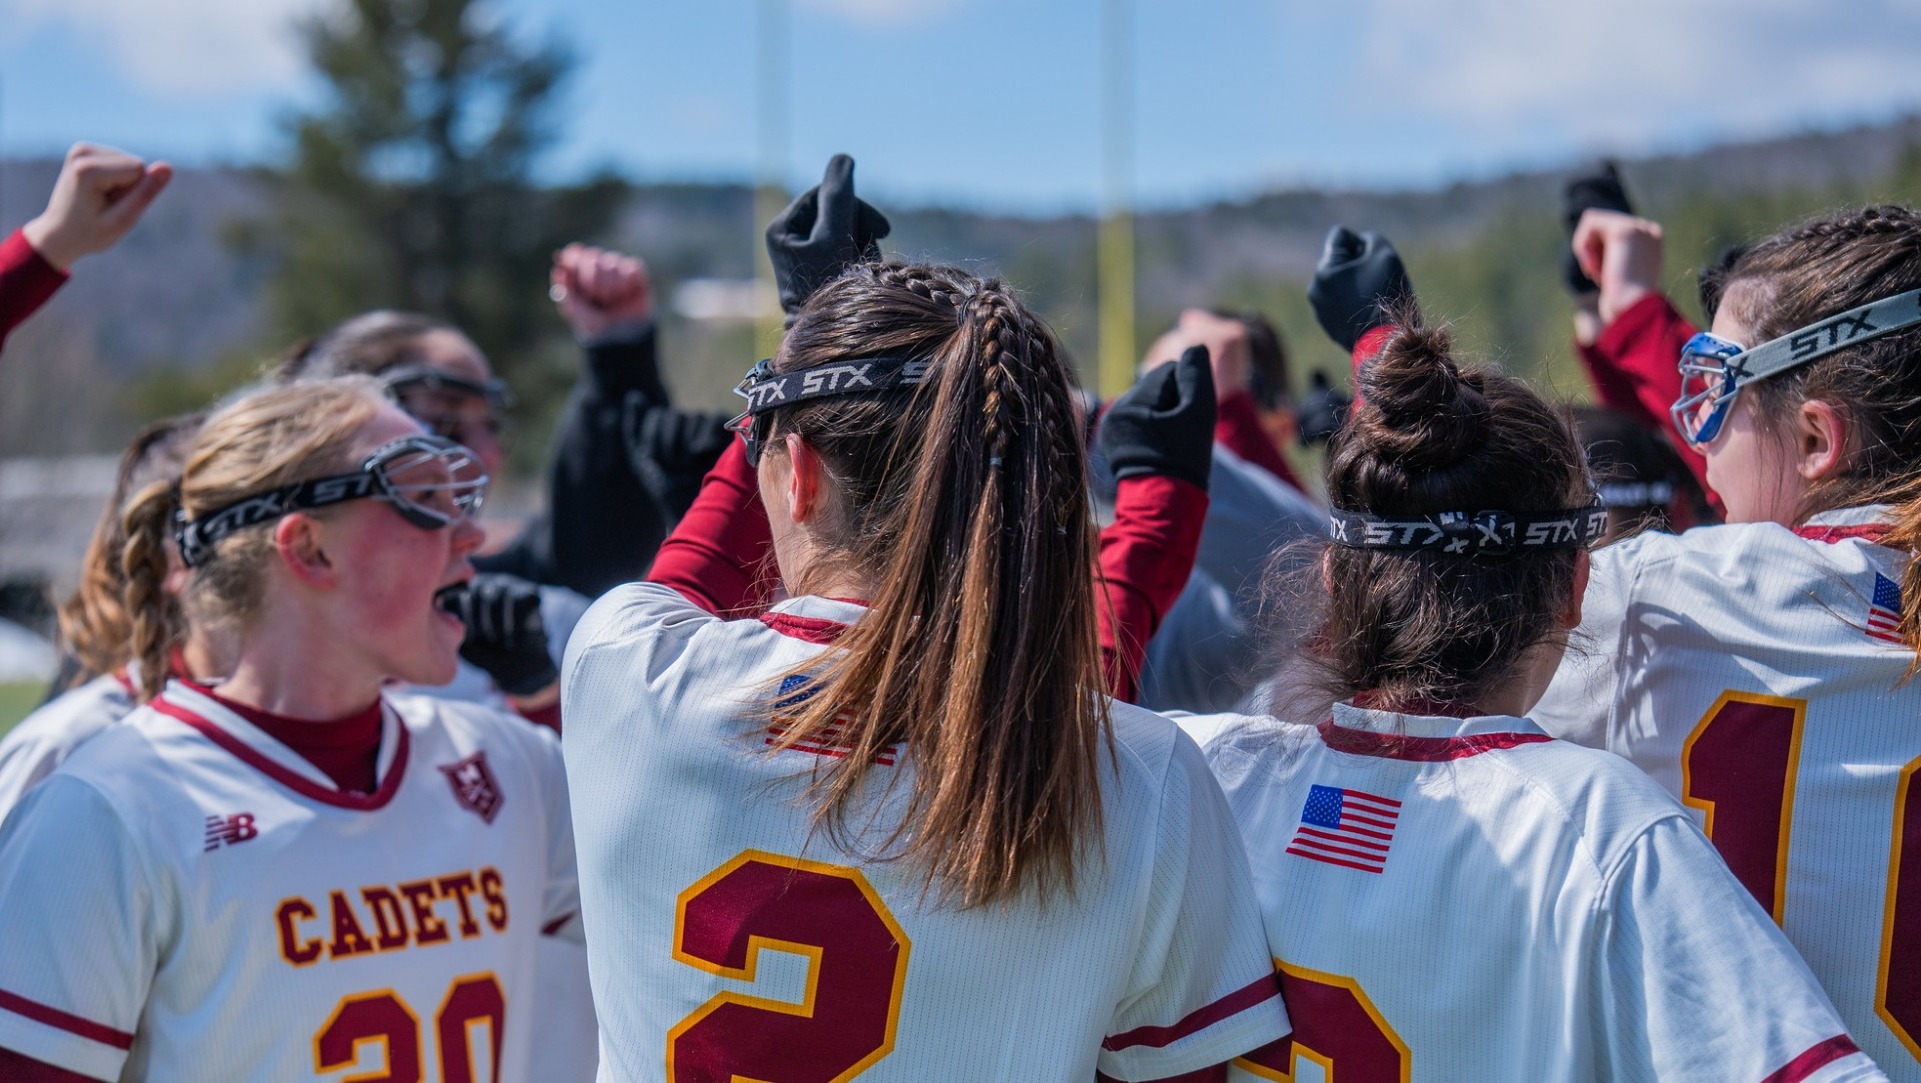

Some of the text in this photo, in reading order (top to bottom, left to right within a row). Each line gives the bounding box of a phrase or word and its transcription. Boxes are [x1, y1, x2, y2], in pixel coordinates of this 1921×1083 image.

[1789, 308, 1878, 361] STX
[801, 363, 873, 395] STX
[312, 474, 372, 498] ST
[1523, 518, 1579, 545] STX
[1585, 511, 1608, 538] ST
[203, 812, 258, 853] NB
[274, 866, 509, 969] CADETS
[665, 848, 912, 1083] 2
[312, 970, 508, 1083] 20
